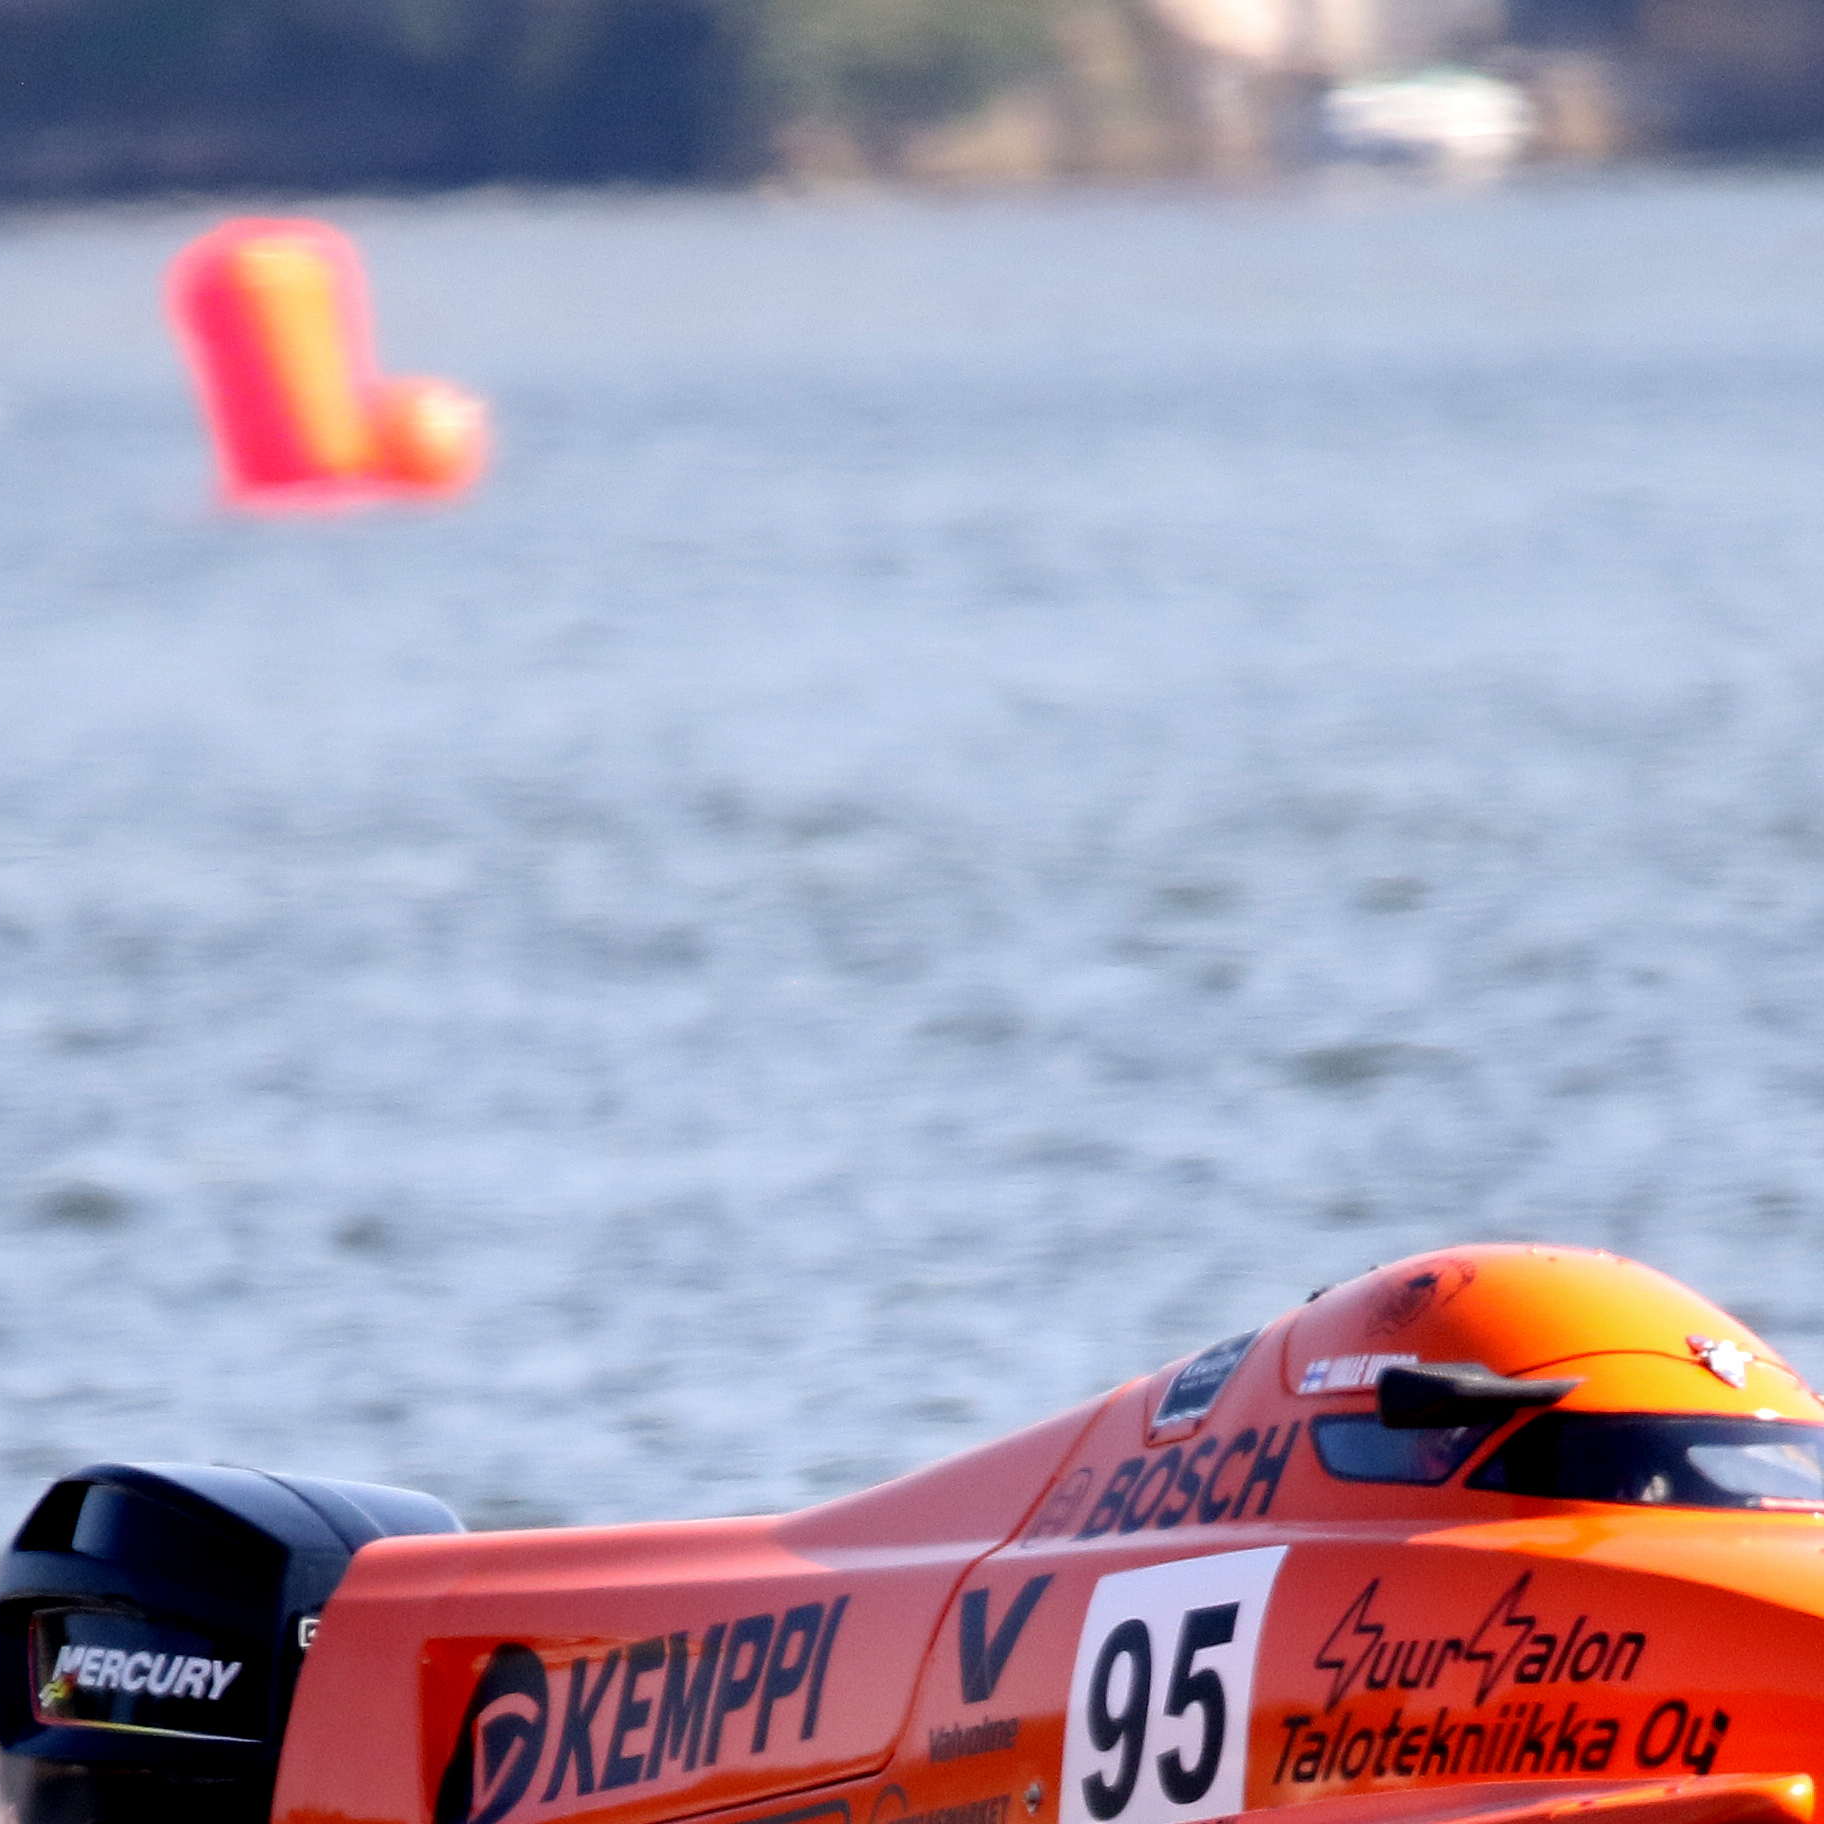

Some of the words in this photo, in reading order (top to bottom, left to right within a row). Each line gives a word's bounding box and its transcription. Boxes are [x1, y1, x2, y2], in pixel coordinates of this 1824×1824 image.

[1077, 1420, 1301, 1542] BOSCH
[53, 1645, 243, 1700] MERCURY
[540, 1594, 851, 1803] KEMPPI
[1080, 1601, 1240, 1822] 95
[1272, 1702, 1619, 1785] Talotekniikka
[1635, 1700, 1730, 1776] Oy
